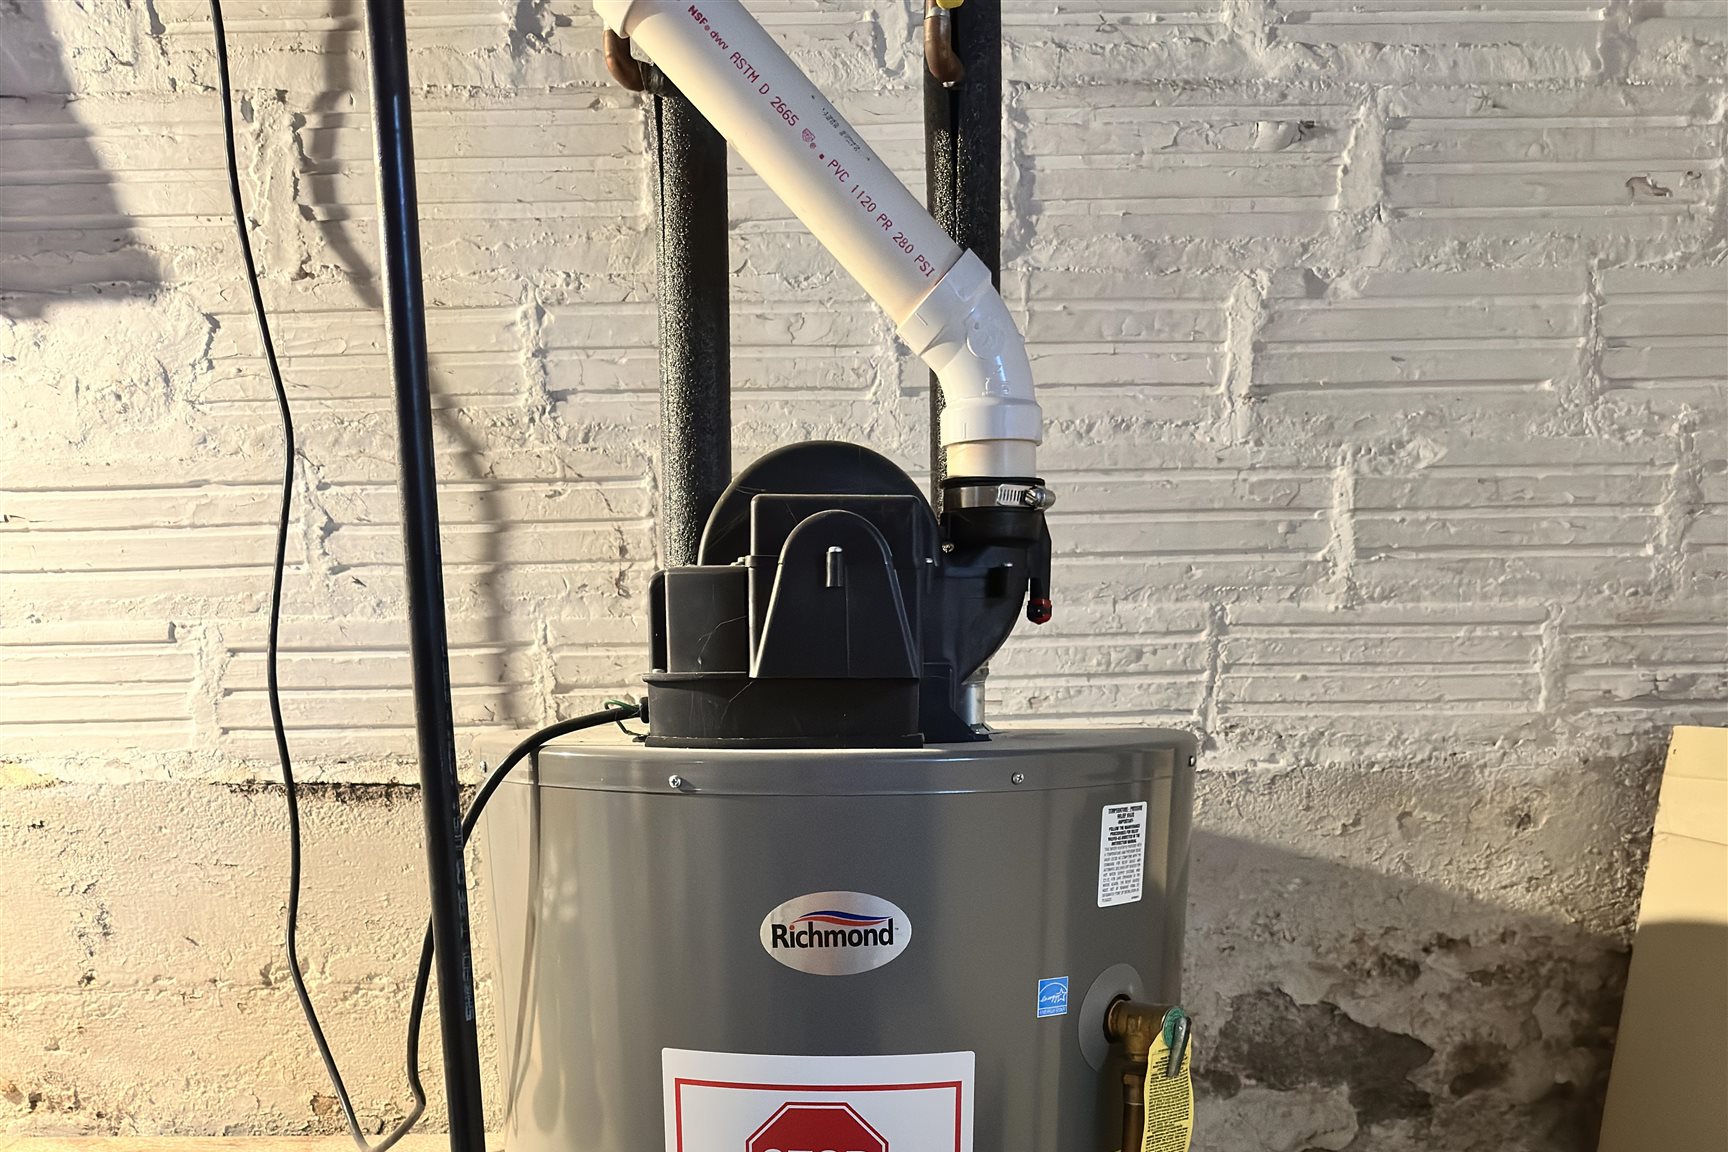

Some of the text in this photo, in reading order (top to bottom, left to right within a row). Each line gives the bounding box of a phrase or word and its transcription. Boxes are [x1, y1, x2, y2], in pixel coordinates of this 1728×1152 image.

[730, 51, 760, 83] ASTM
[759, 83, 770, 94] D
[770, 96, 799, 126] 2665
[827, 159, 850, 183] PVC
[851, 184, 877, 213] 1120
[876, 213, 893, 231] PR
[892, 231, 914, 254] 280
[914, 254, 935, 277] PSI
[771, 918, 894, 949] Richmond
